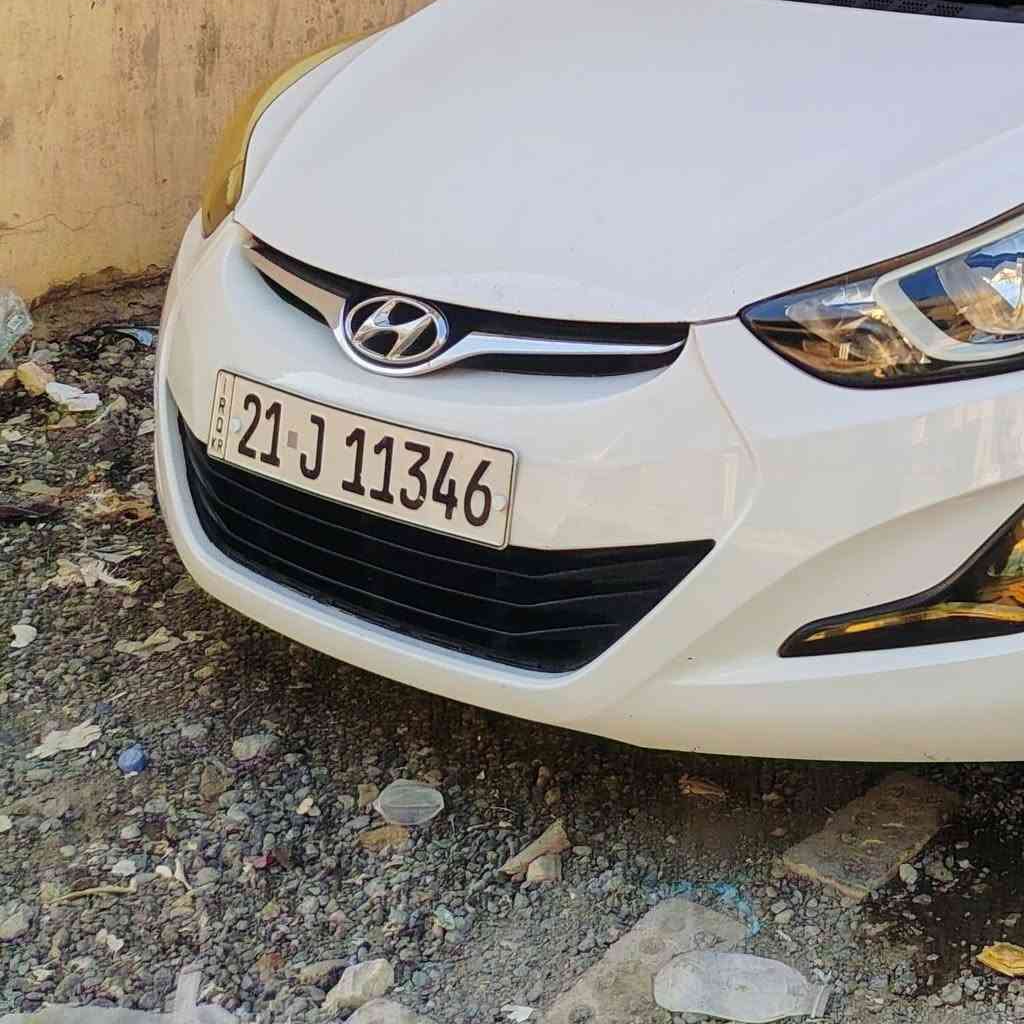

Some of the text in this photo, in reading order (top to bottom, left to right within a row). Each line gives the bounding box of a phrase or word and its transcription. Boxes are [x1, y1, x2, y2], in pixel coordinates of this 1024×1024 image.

[238, 393, 492, 526] 21 J 11346
